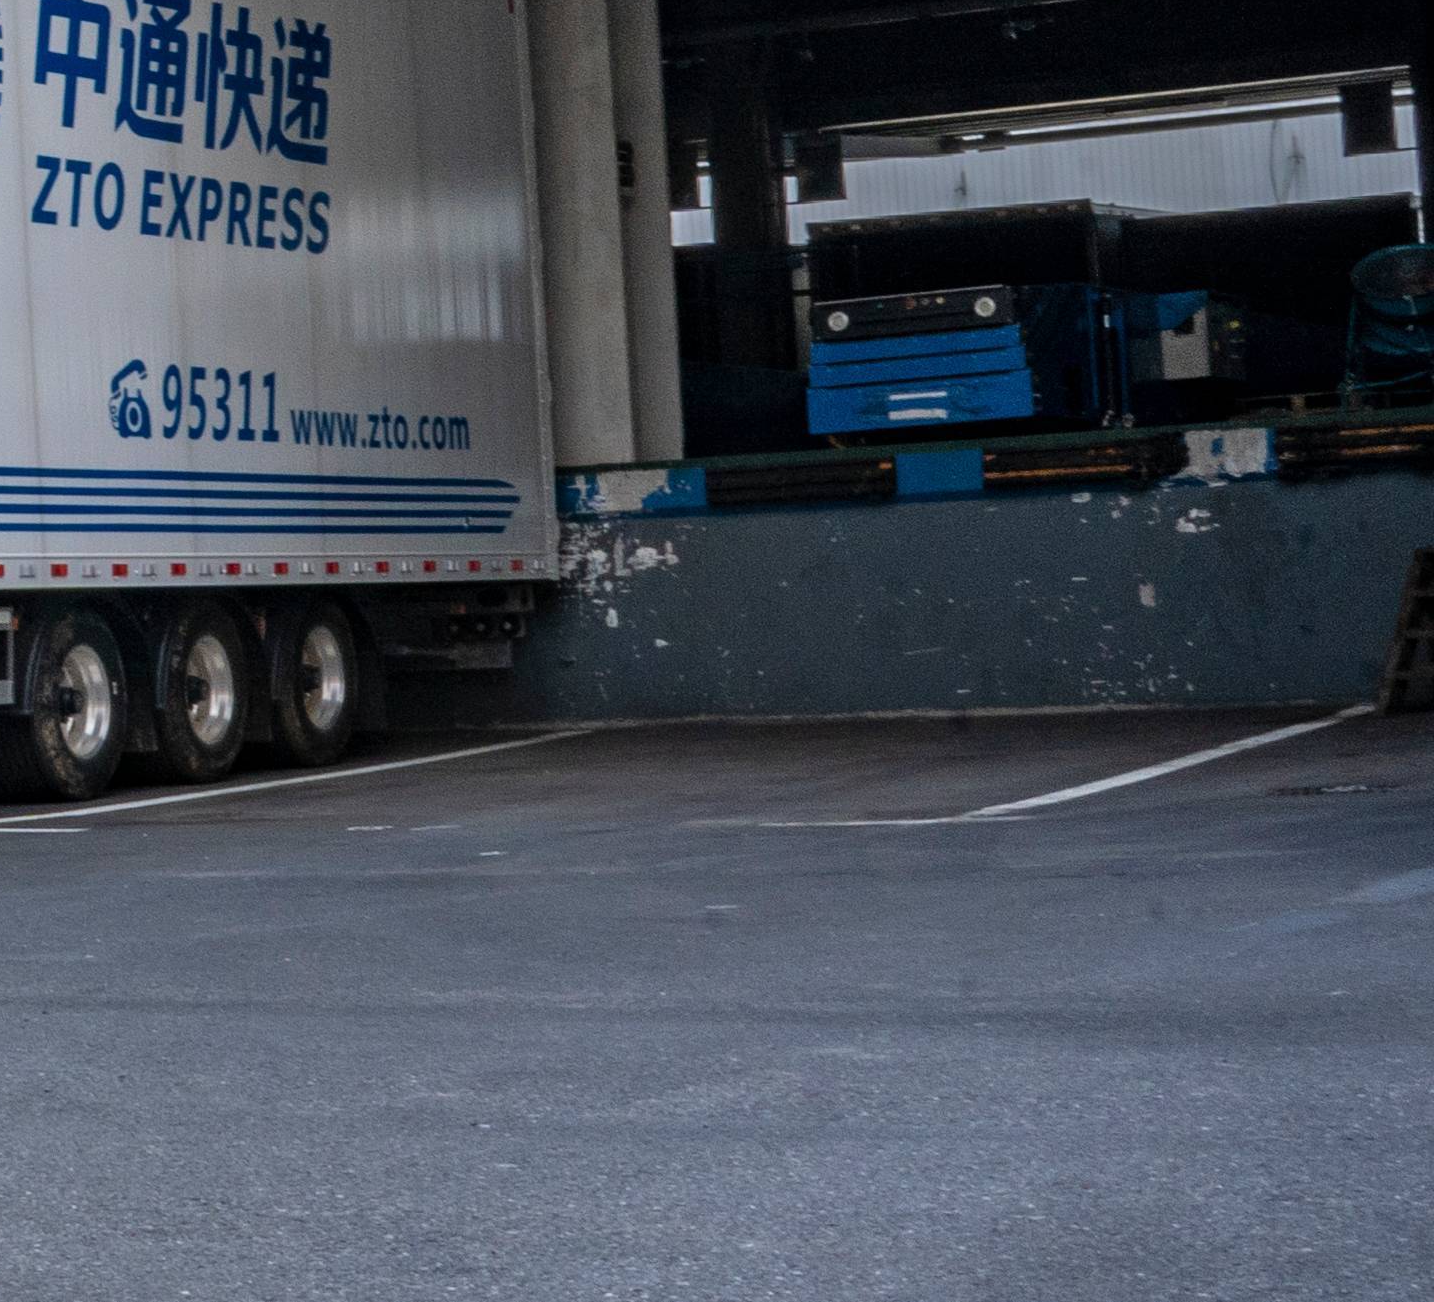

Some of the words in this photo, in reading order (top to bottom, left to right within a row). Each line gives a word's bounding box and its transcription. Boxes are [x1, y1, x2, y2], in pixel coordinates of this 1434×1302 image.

[31, 155, 125, 231] ZTO
[140, 170, 331, 255] EXPRESS
[162, 364, 280, 443] 95311
[290, 406, 471, 451] www.zto.com
